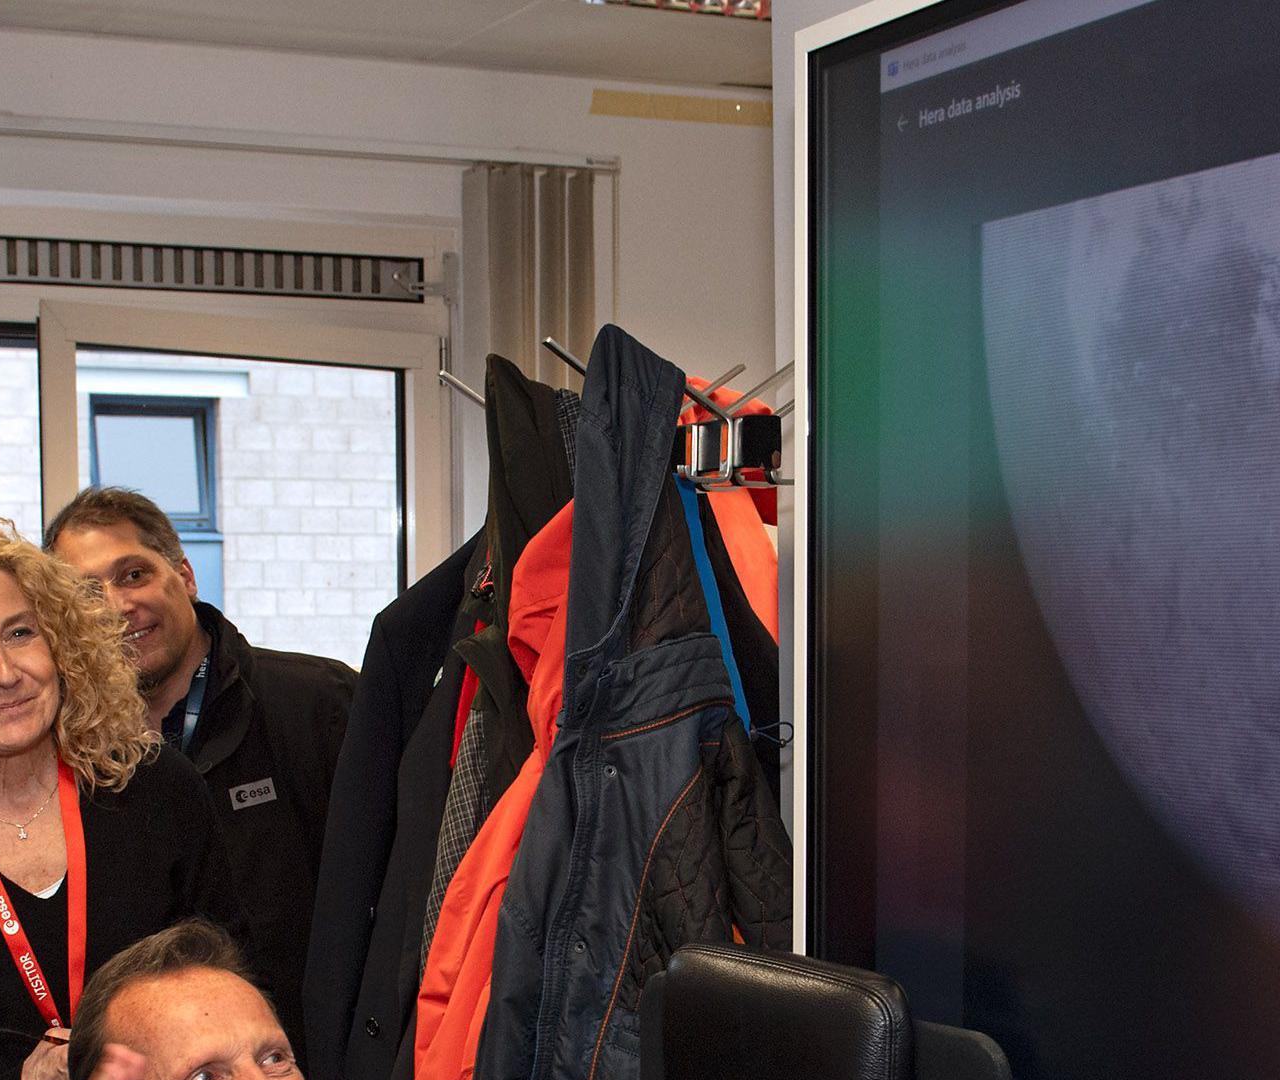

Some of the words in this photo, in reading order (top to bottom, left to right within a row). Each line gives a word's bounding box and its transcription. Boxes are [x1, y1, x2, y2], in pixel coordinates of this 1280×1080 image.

[919, 108, 945, 128] Hera
[947, 99, 972, 119] data
[975, 80, 1021, 109] analysis
[20, 952, 48, 1001] VISITOR
